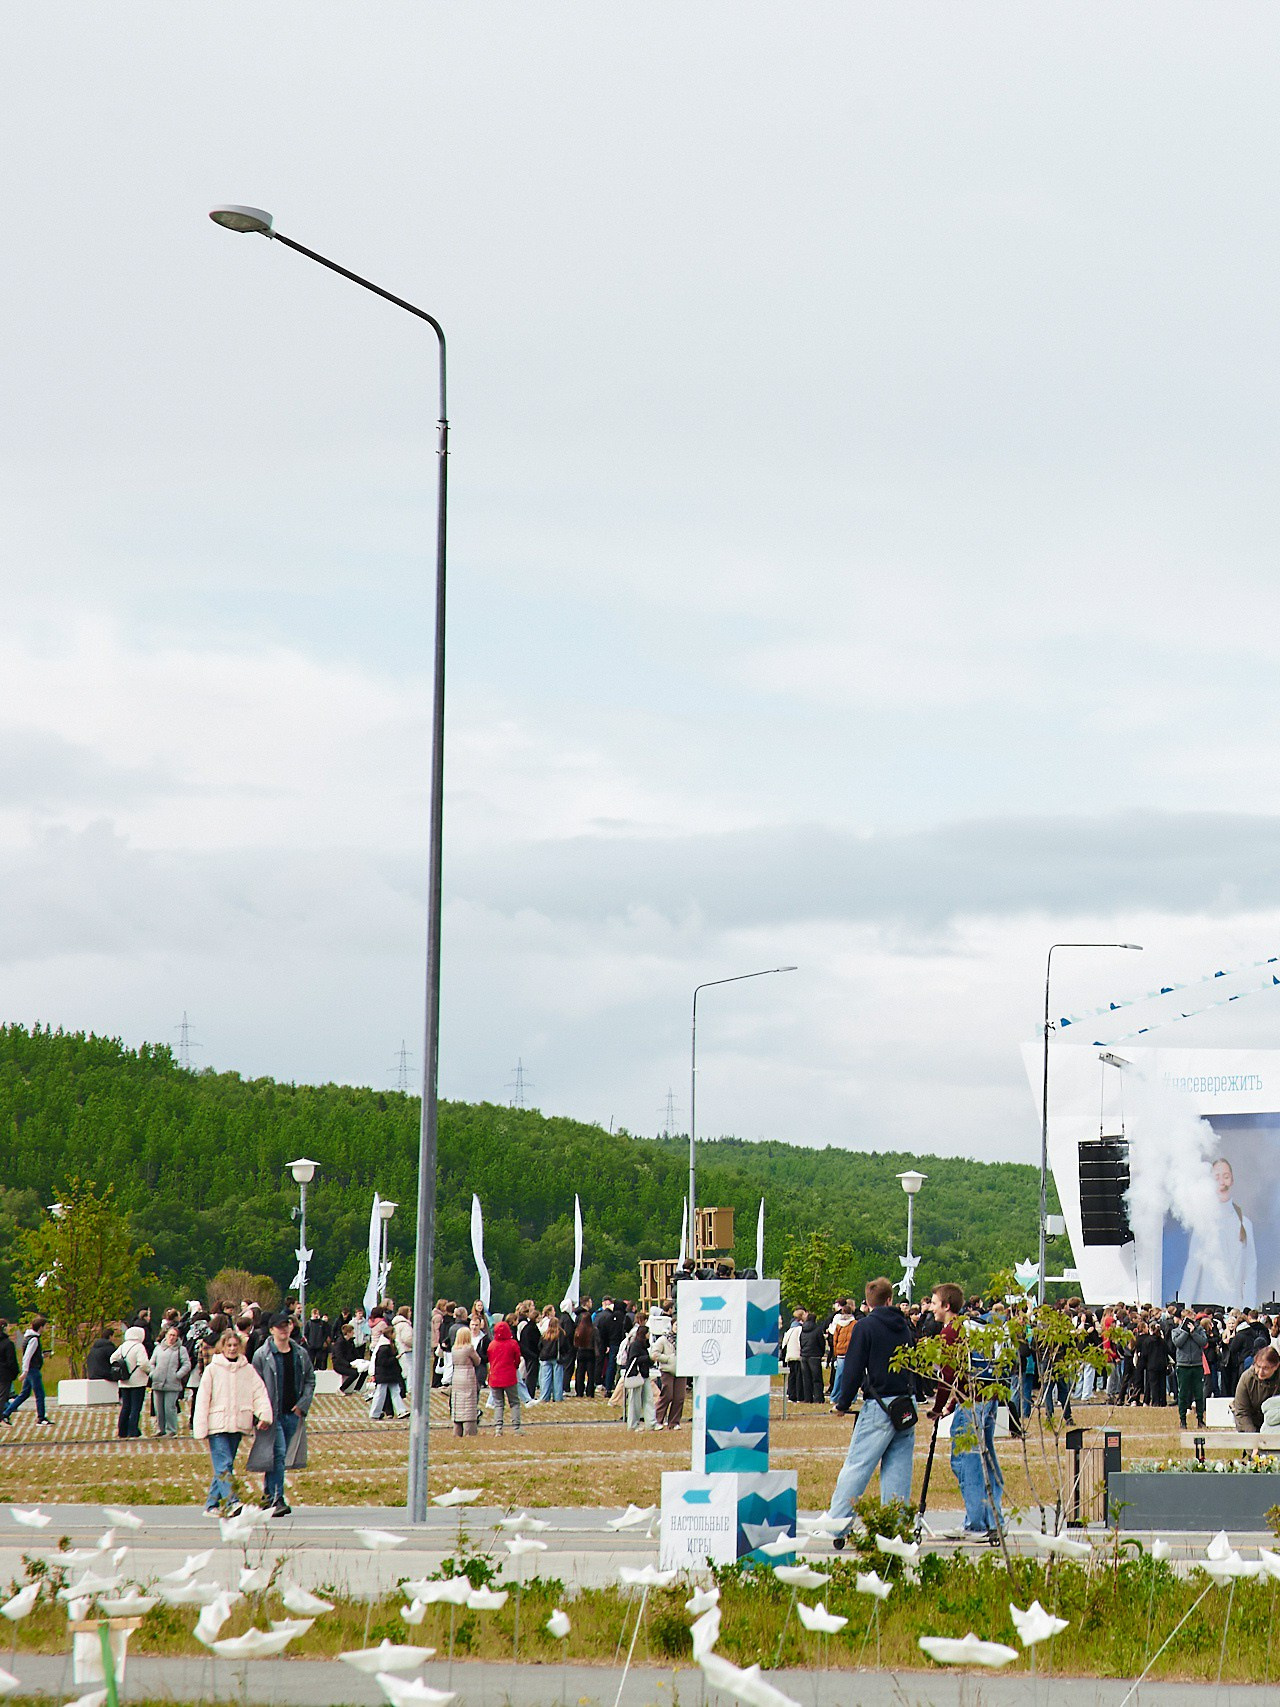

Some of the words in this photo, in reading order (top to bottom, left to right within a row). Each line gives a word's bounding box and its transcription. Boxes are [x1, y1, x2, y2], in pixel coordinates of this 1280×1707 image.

[693, 1318, 731, 1333] ВОЛЕЙБОЛ
[671, 1516, 729, 1531] НАСТОЛЬНЫЕ
[687, 1538, 711, 1553] ИГРЫ
